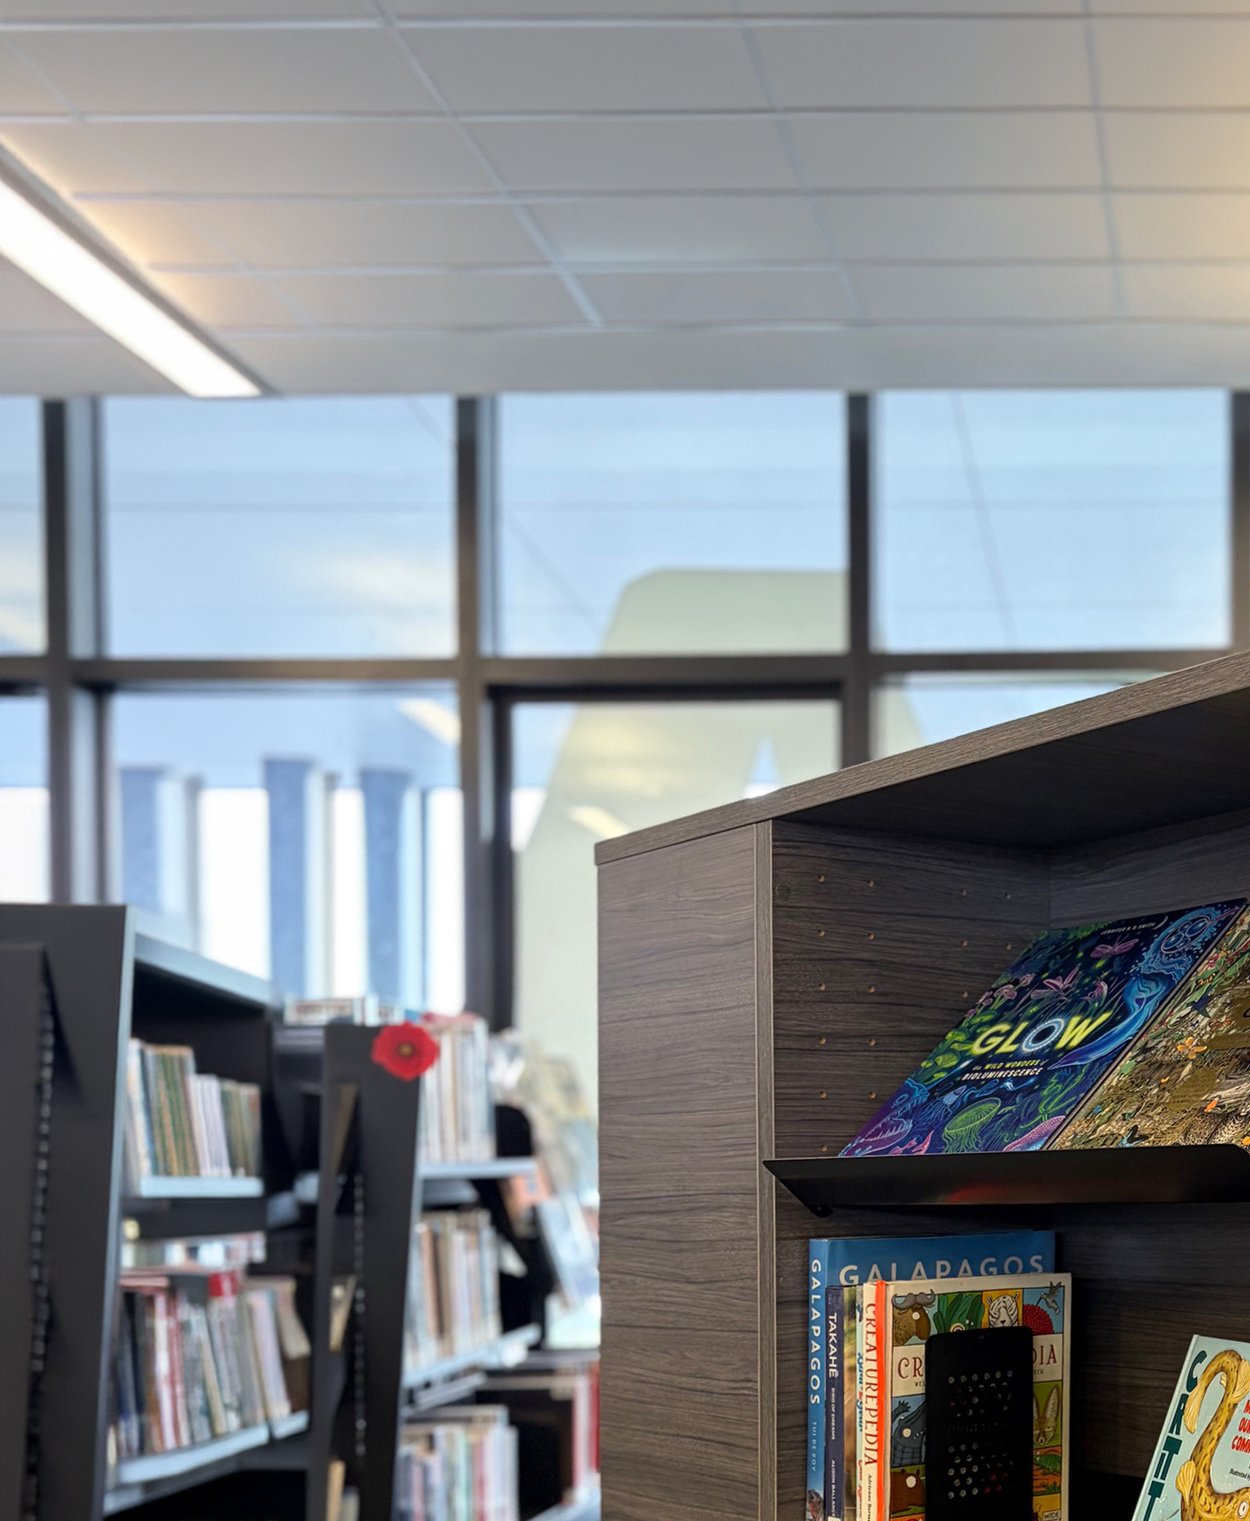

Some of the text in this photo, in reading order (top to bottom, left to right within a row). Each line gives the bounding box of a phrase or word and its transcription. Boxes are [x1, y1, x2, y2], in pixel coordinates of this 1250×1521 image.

[971, 1010, 1113, 1055] GLOW
[962, 1067, 1044, 1081] BIOLUMINESCENCE
[1004, 1060, 1041, 1068] WONDERS
[810, 1259, 822, 1404] GALAPAGOS
